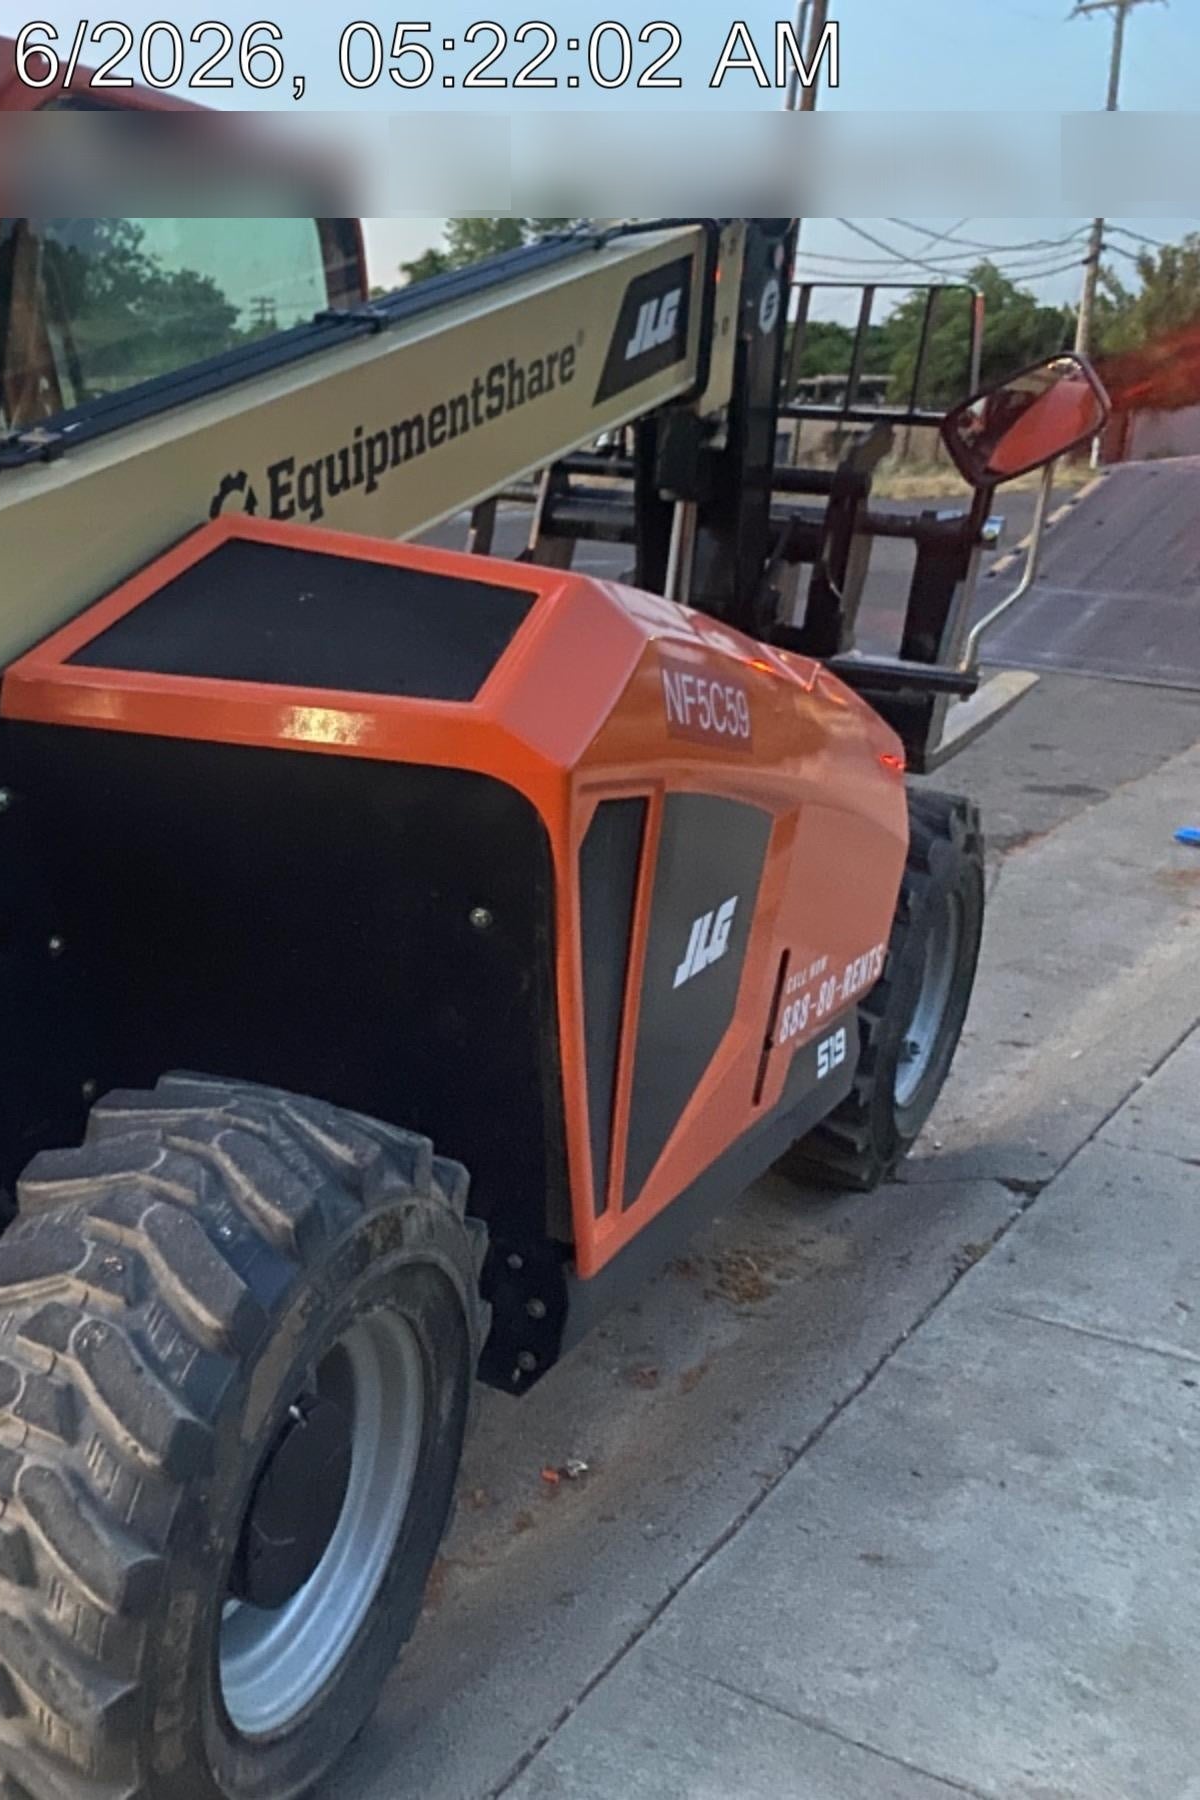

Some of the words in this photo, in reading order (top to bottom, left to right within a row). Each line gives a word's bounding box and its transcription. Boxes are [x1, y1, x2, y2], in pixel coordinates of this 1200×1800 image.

[625, 288, 682, 361] JLG
[266, 345, 576, 522] EquipmentShare
[662, 669, 750, 738] NF5C59
[673, 896, 738, 989] JLG
[817, 1027, 846, 1079] 519
